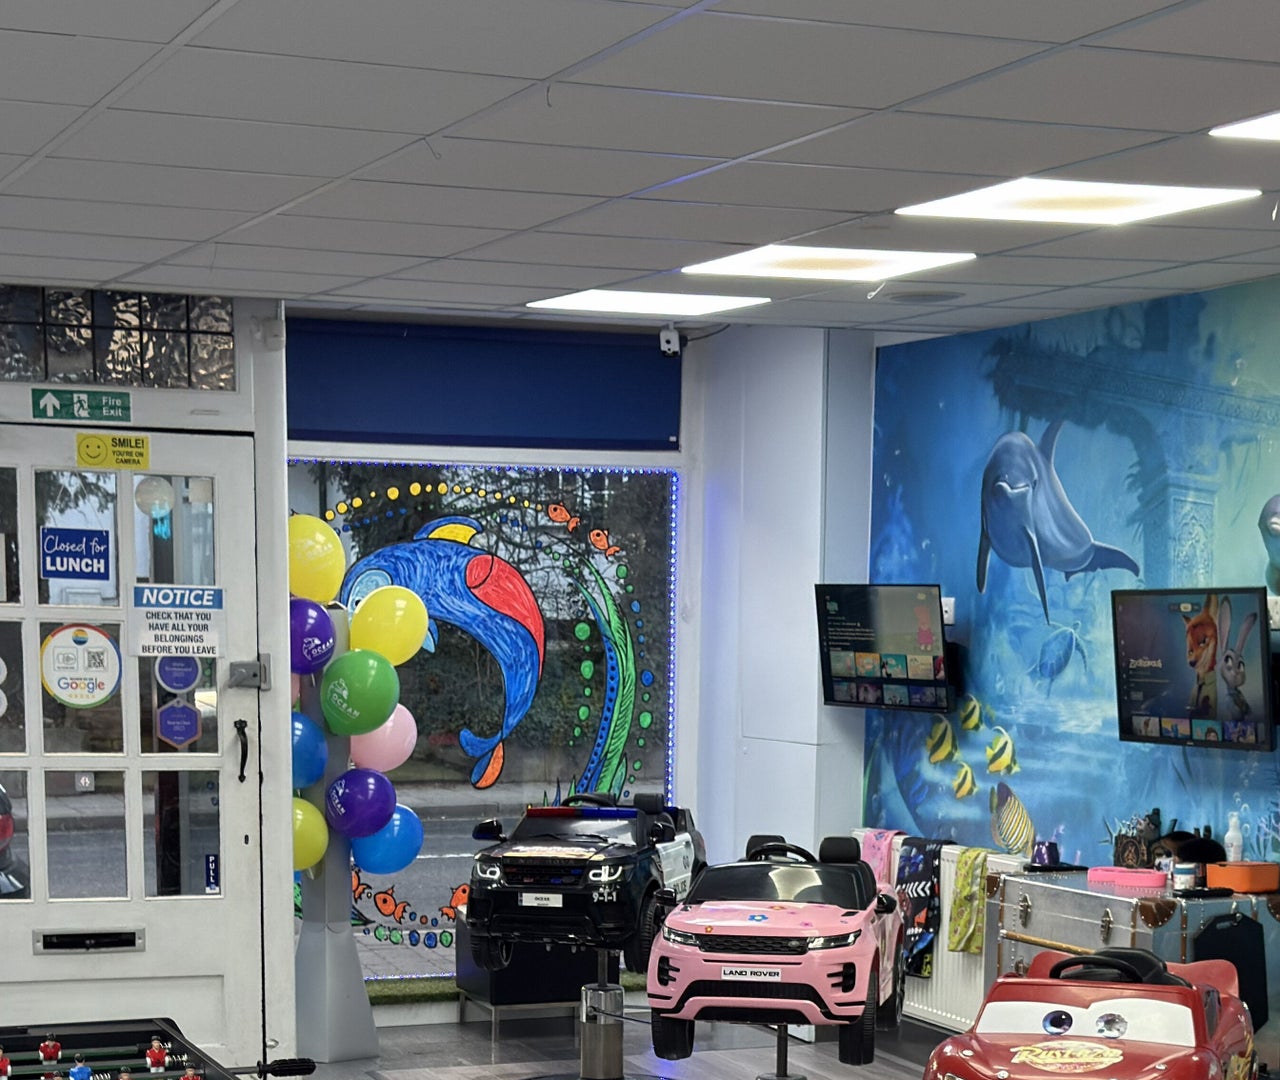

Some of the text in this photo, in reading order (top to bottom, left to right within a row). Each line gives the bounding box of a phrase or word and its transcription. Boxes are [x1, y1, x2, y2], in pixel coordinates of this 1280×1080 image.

[103, 396, 121, 406] Fire
[103, 407, 122, 416] Exit
[111, 438, 144, 448] SMILE!
[44, 535, 107, 555] Closed for
[46, 556, 105, 573] LUNCH
[143, 588, 215, 606] NOTICE
[145, 611, 211, 621] CHECK THAT YOU
[149, 622, 209, 632] HAVE ALL YOUR
[154, 634, 204, 643] BELONGINGS
[142, 645, 216, 655] BEFORE YOU LEAVE
[312, 637, 335, 656] OCEAN
[57, 676, 106, 693] Google
[332, 693, 360, 718] OCEAN
[592, 891, 617, 903] 9-1-1
[723, 969, 780, 978] LAND ROVER
